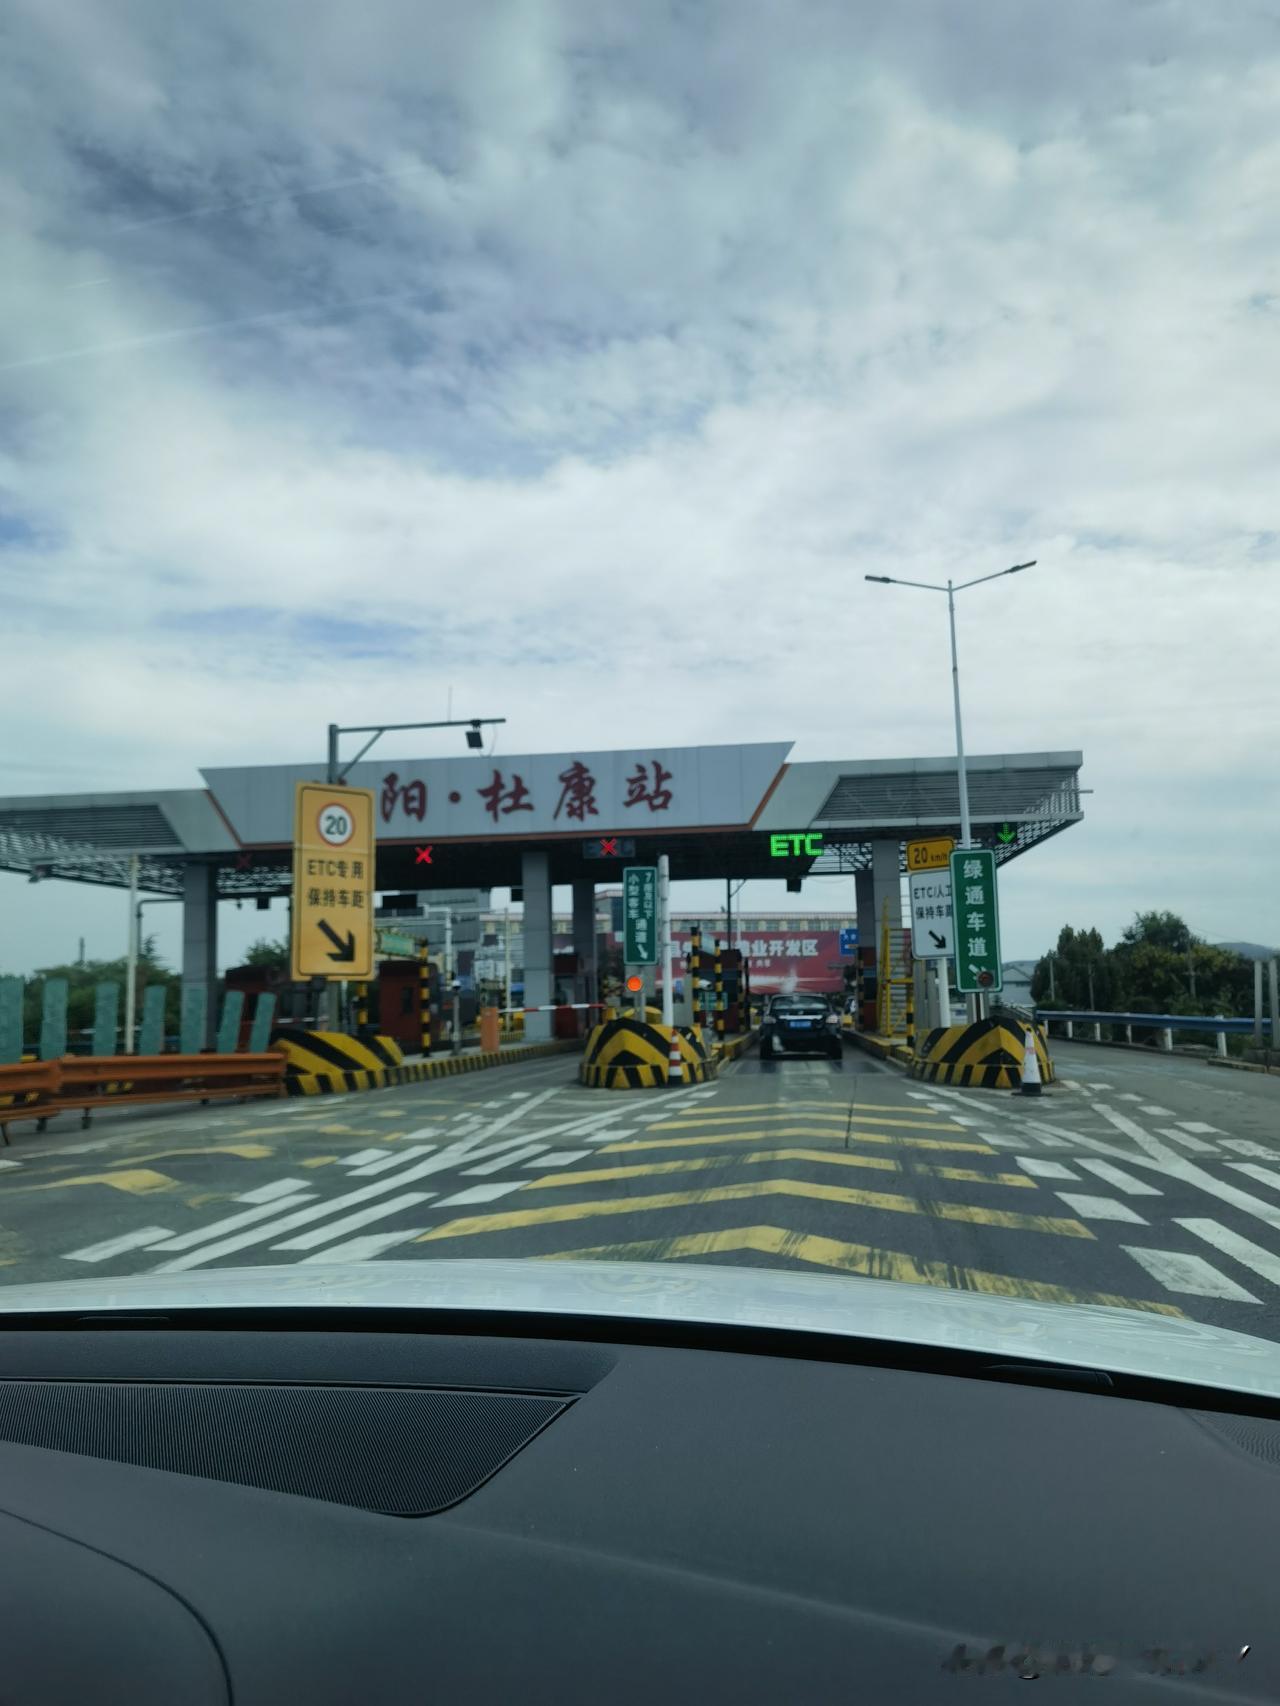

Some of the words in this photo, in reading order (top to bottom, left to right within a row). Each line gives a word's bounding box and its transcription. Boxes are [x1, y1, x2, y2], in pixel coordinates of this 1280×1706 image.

[380, 760, 674, 823] 阳·杜康站
[325, 814, 348, 836] 20
[770, 833, 824, 857] ETC
[913, 847, 928, 865] 20
[307, 859, 364, 879] ETC专用
[308, 887, 364, 908] 保持车距
[963, 859, 988, 957] 绿通车道
